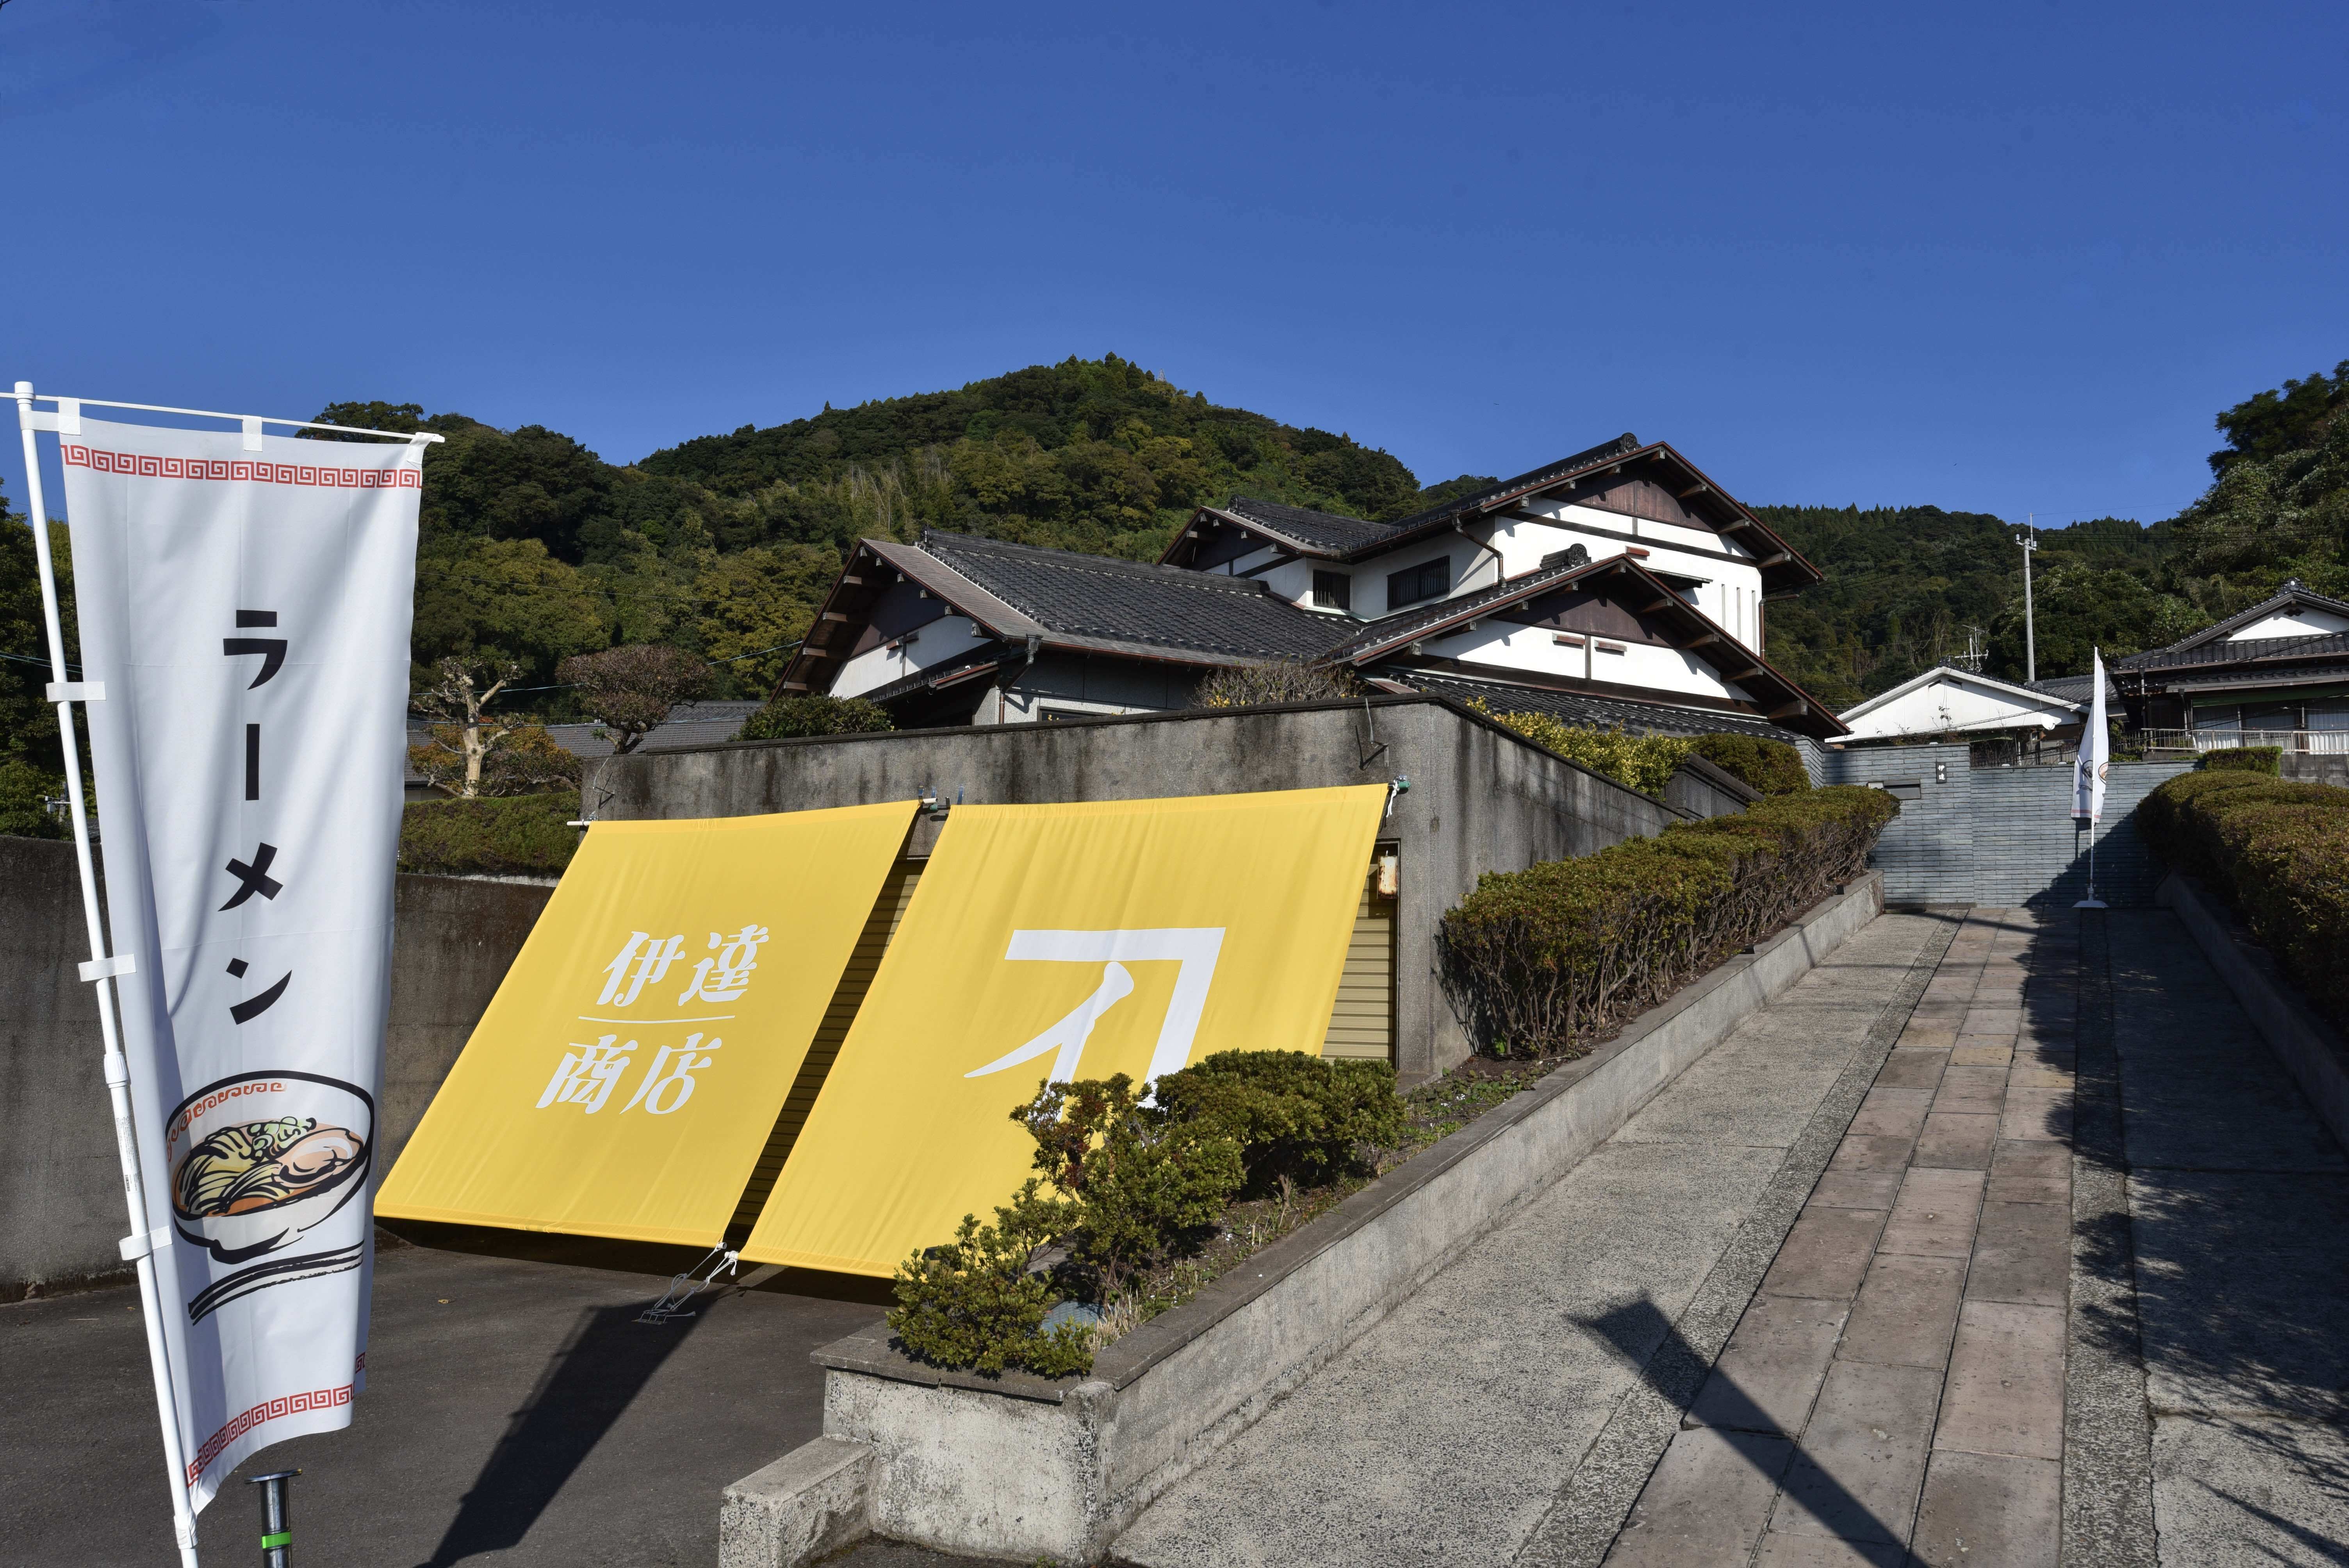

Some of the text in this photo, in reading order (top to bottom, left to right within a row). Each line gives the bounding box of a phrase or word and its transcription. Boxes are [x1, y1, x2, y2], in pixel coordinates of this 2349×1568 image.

[218, 609, 292, 1025] ラーメン
[596, 924, 769, 1007] 伊達
[535, 1032, 722, 1115] 商店
